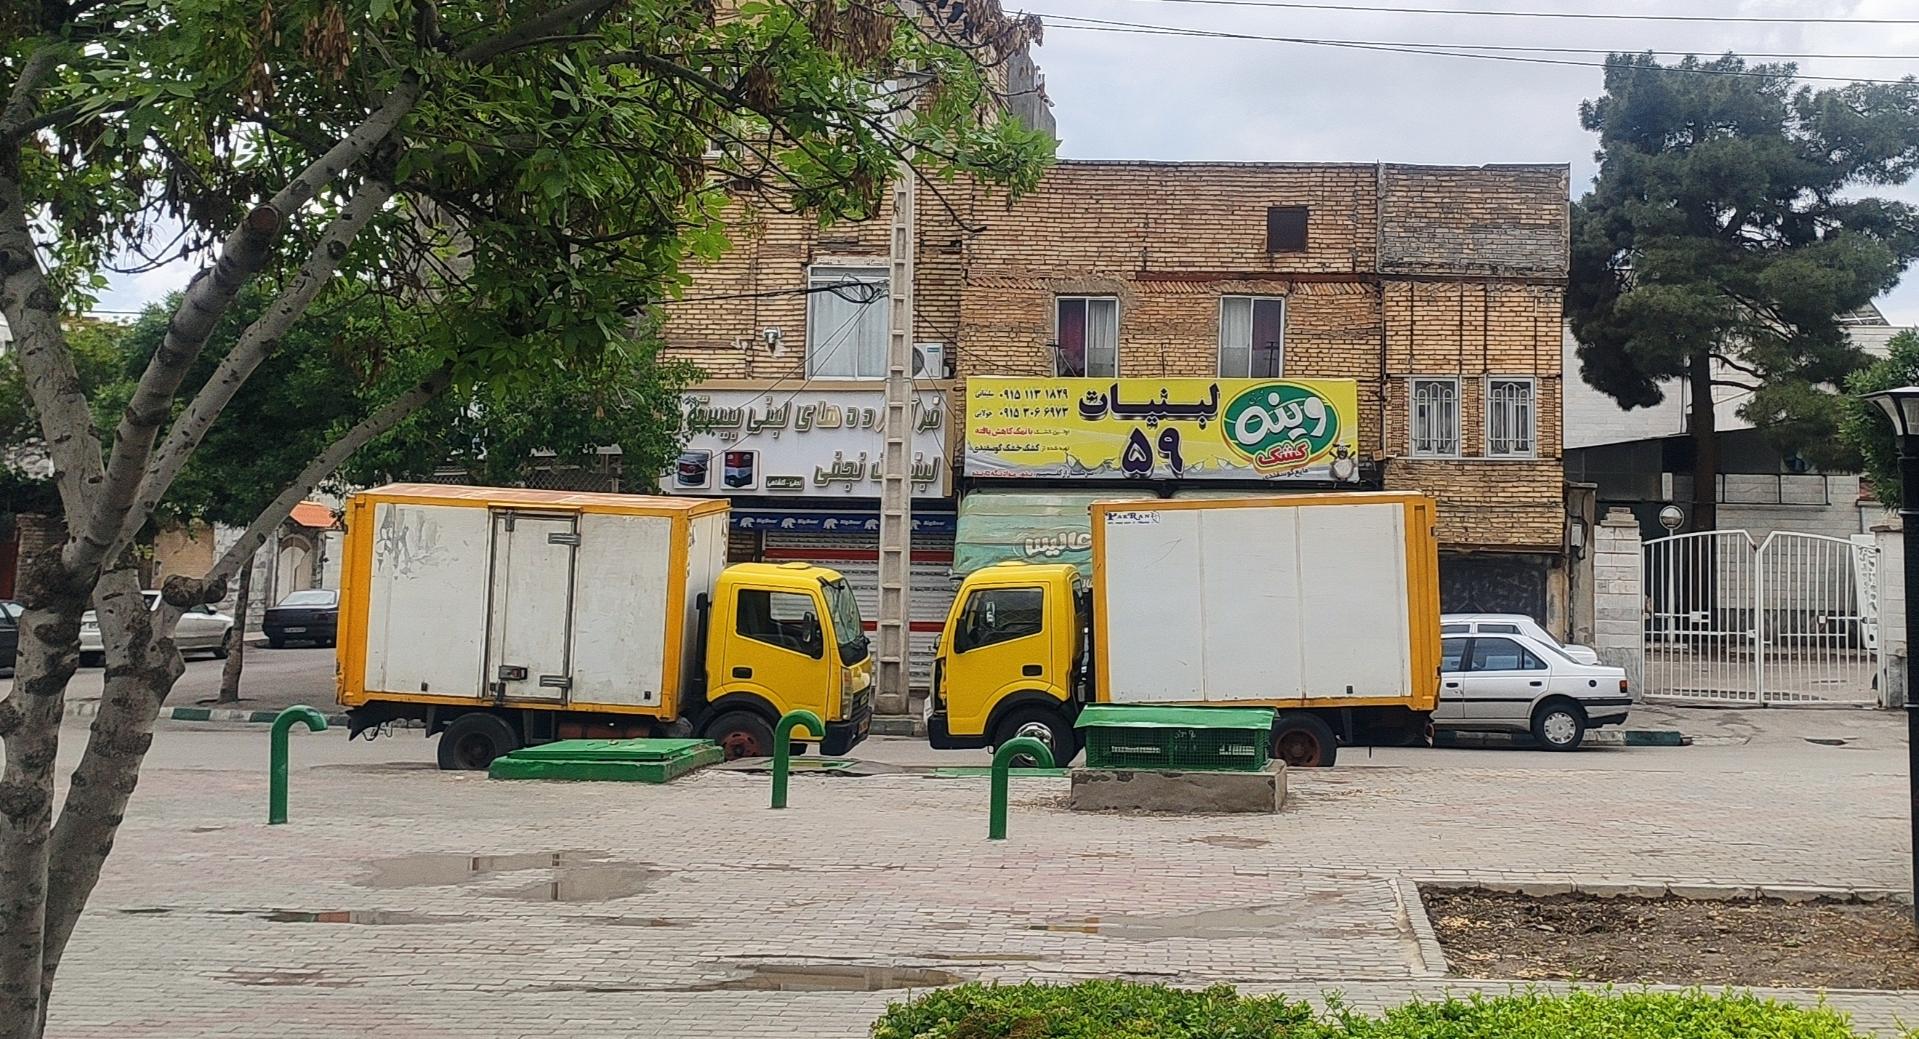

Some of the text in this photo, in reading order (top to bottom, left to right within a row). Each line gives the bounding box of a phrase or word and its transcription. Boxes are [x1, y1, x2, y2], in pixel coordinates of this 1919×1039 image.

[999, 388, 1069, 400] ۰۹۱۵ ۱۱۳ ۱۸۲۹
[1079, 382, 1220, 429] لبنیات
[746, 396, 792, 438] لبنی
[999, 406, 1069, 418] ۰۹۱۵ ۳۰۶ ۶۹۷۳
[1234, 392, 1327, 445] وینه
[972, 443, 1003, 454] گوسفندی
[1003, 443, 1022, 452] خشک
[1023, 443, 1040, 452] کشک
[1121, 427, 1184, 478] ۵۹
[1258, 442, 1309, 466] کشک
[813, 451, 866, 491] نجفی
